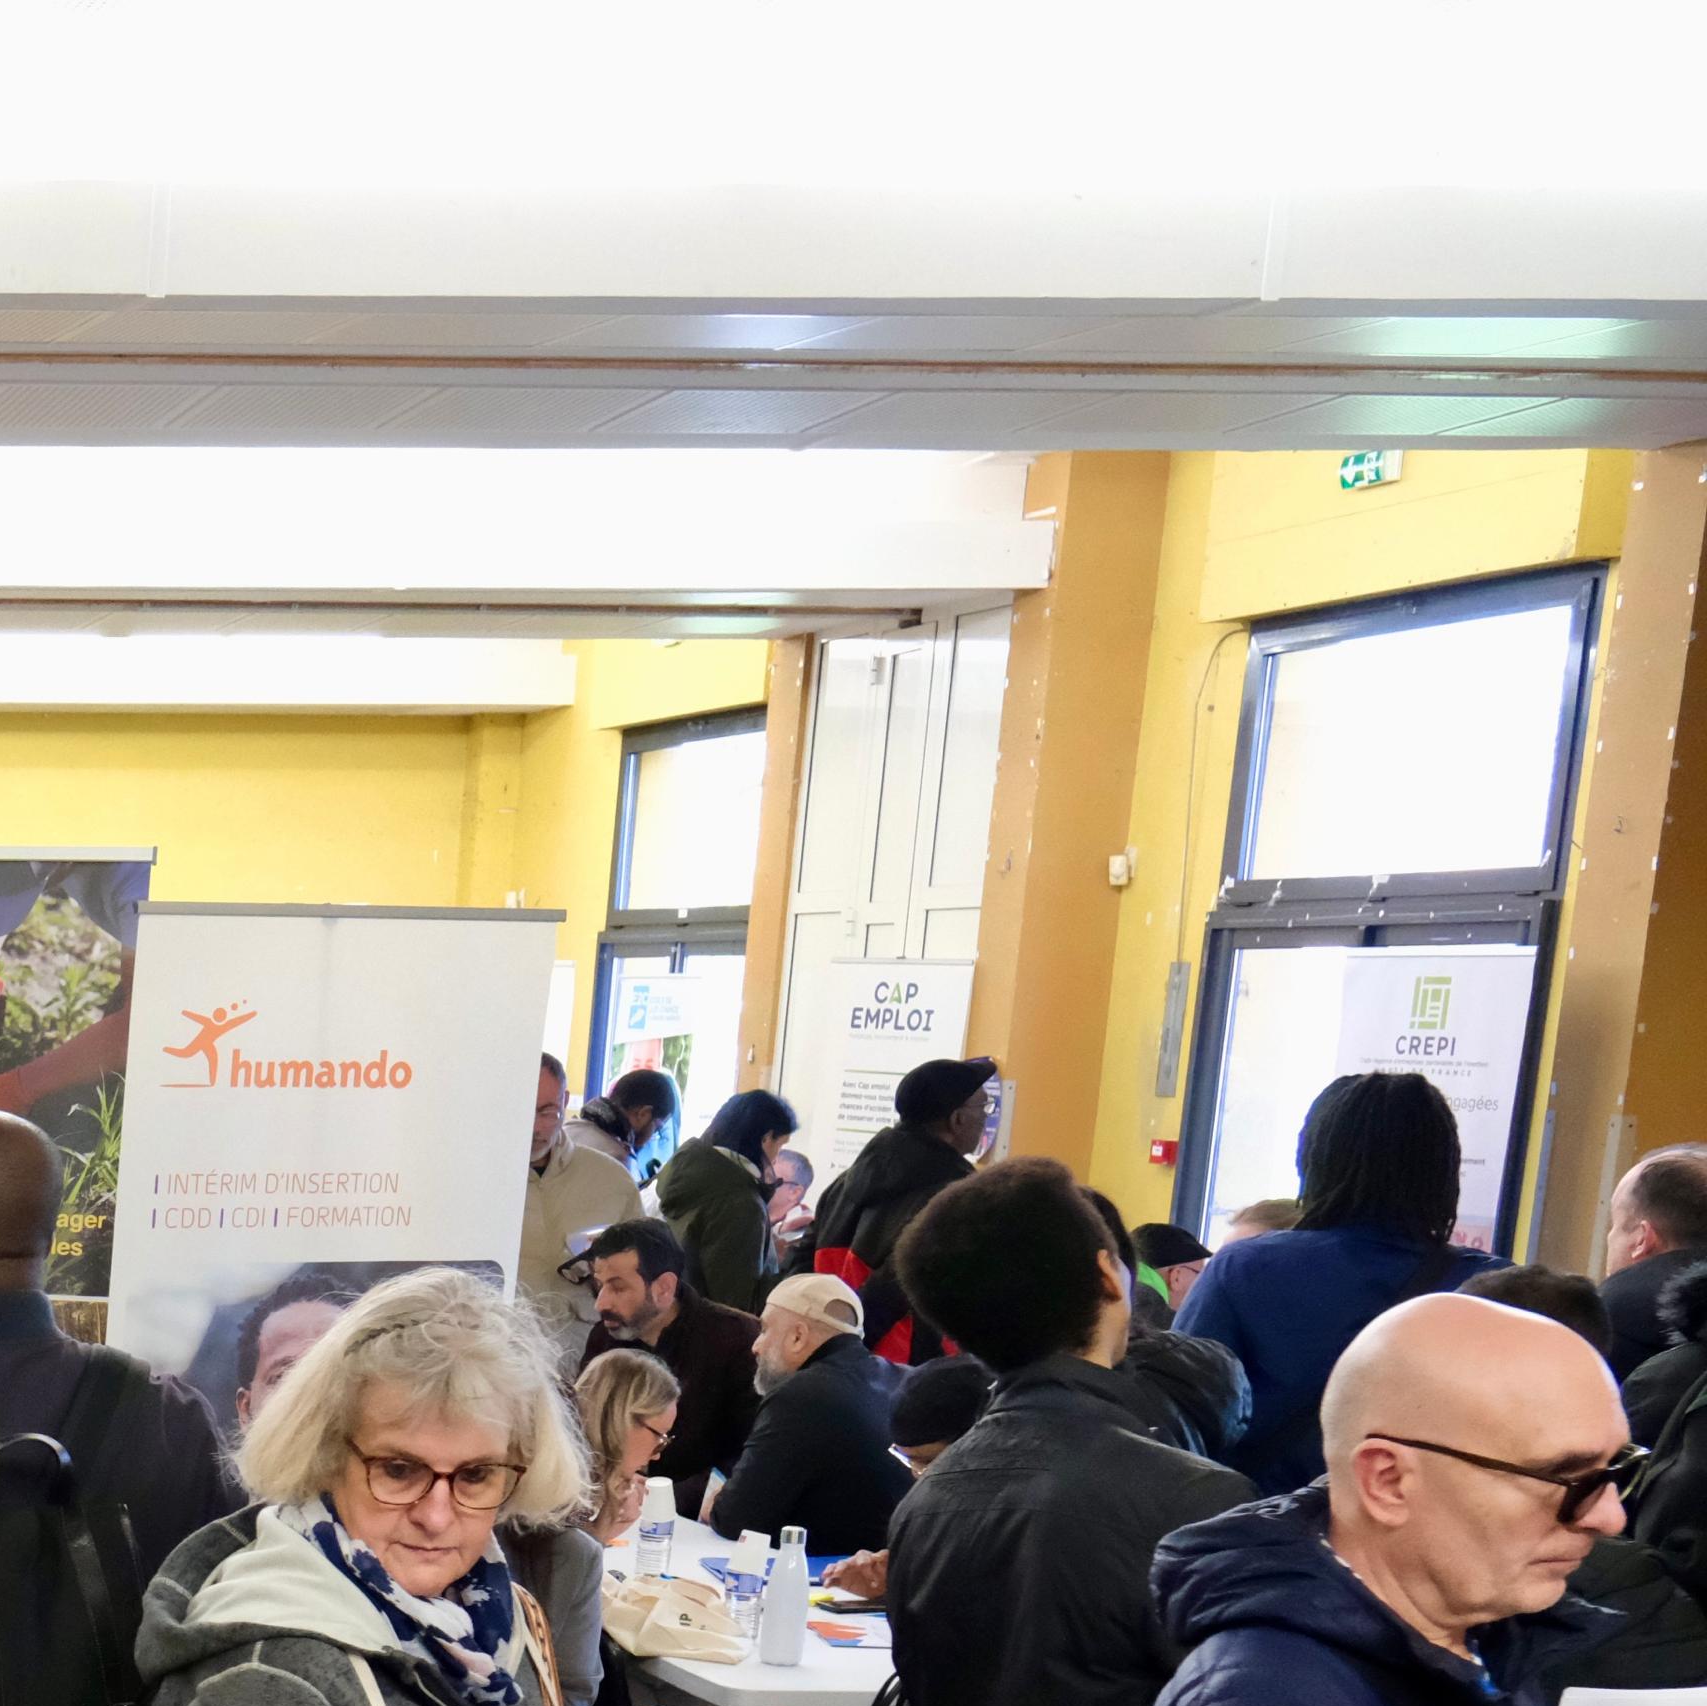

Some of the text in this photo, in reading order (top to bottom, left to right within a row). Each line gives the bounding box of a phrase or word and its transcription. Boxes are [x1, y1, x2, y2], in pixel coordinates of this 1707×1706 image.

[874, 982, 919, 1004] CAP
[850, 1007, 934, 1031] EMPLOI
[1396, 1036, 1456, 1056] CREPI
[230, 1049, 412, 1089] humando
[167, 1169, 399, 1195] INTÉRIM D'INSERTION
[165, 1206, 412, 1228] CDD CDI FORMATION
